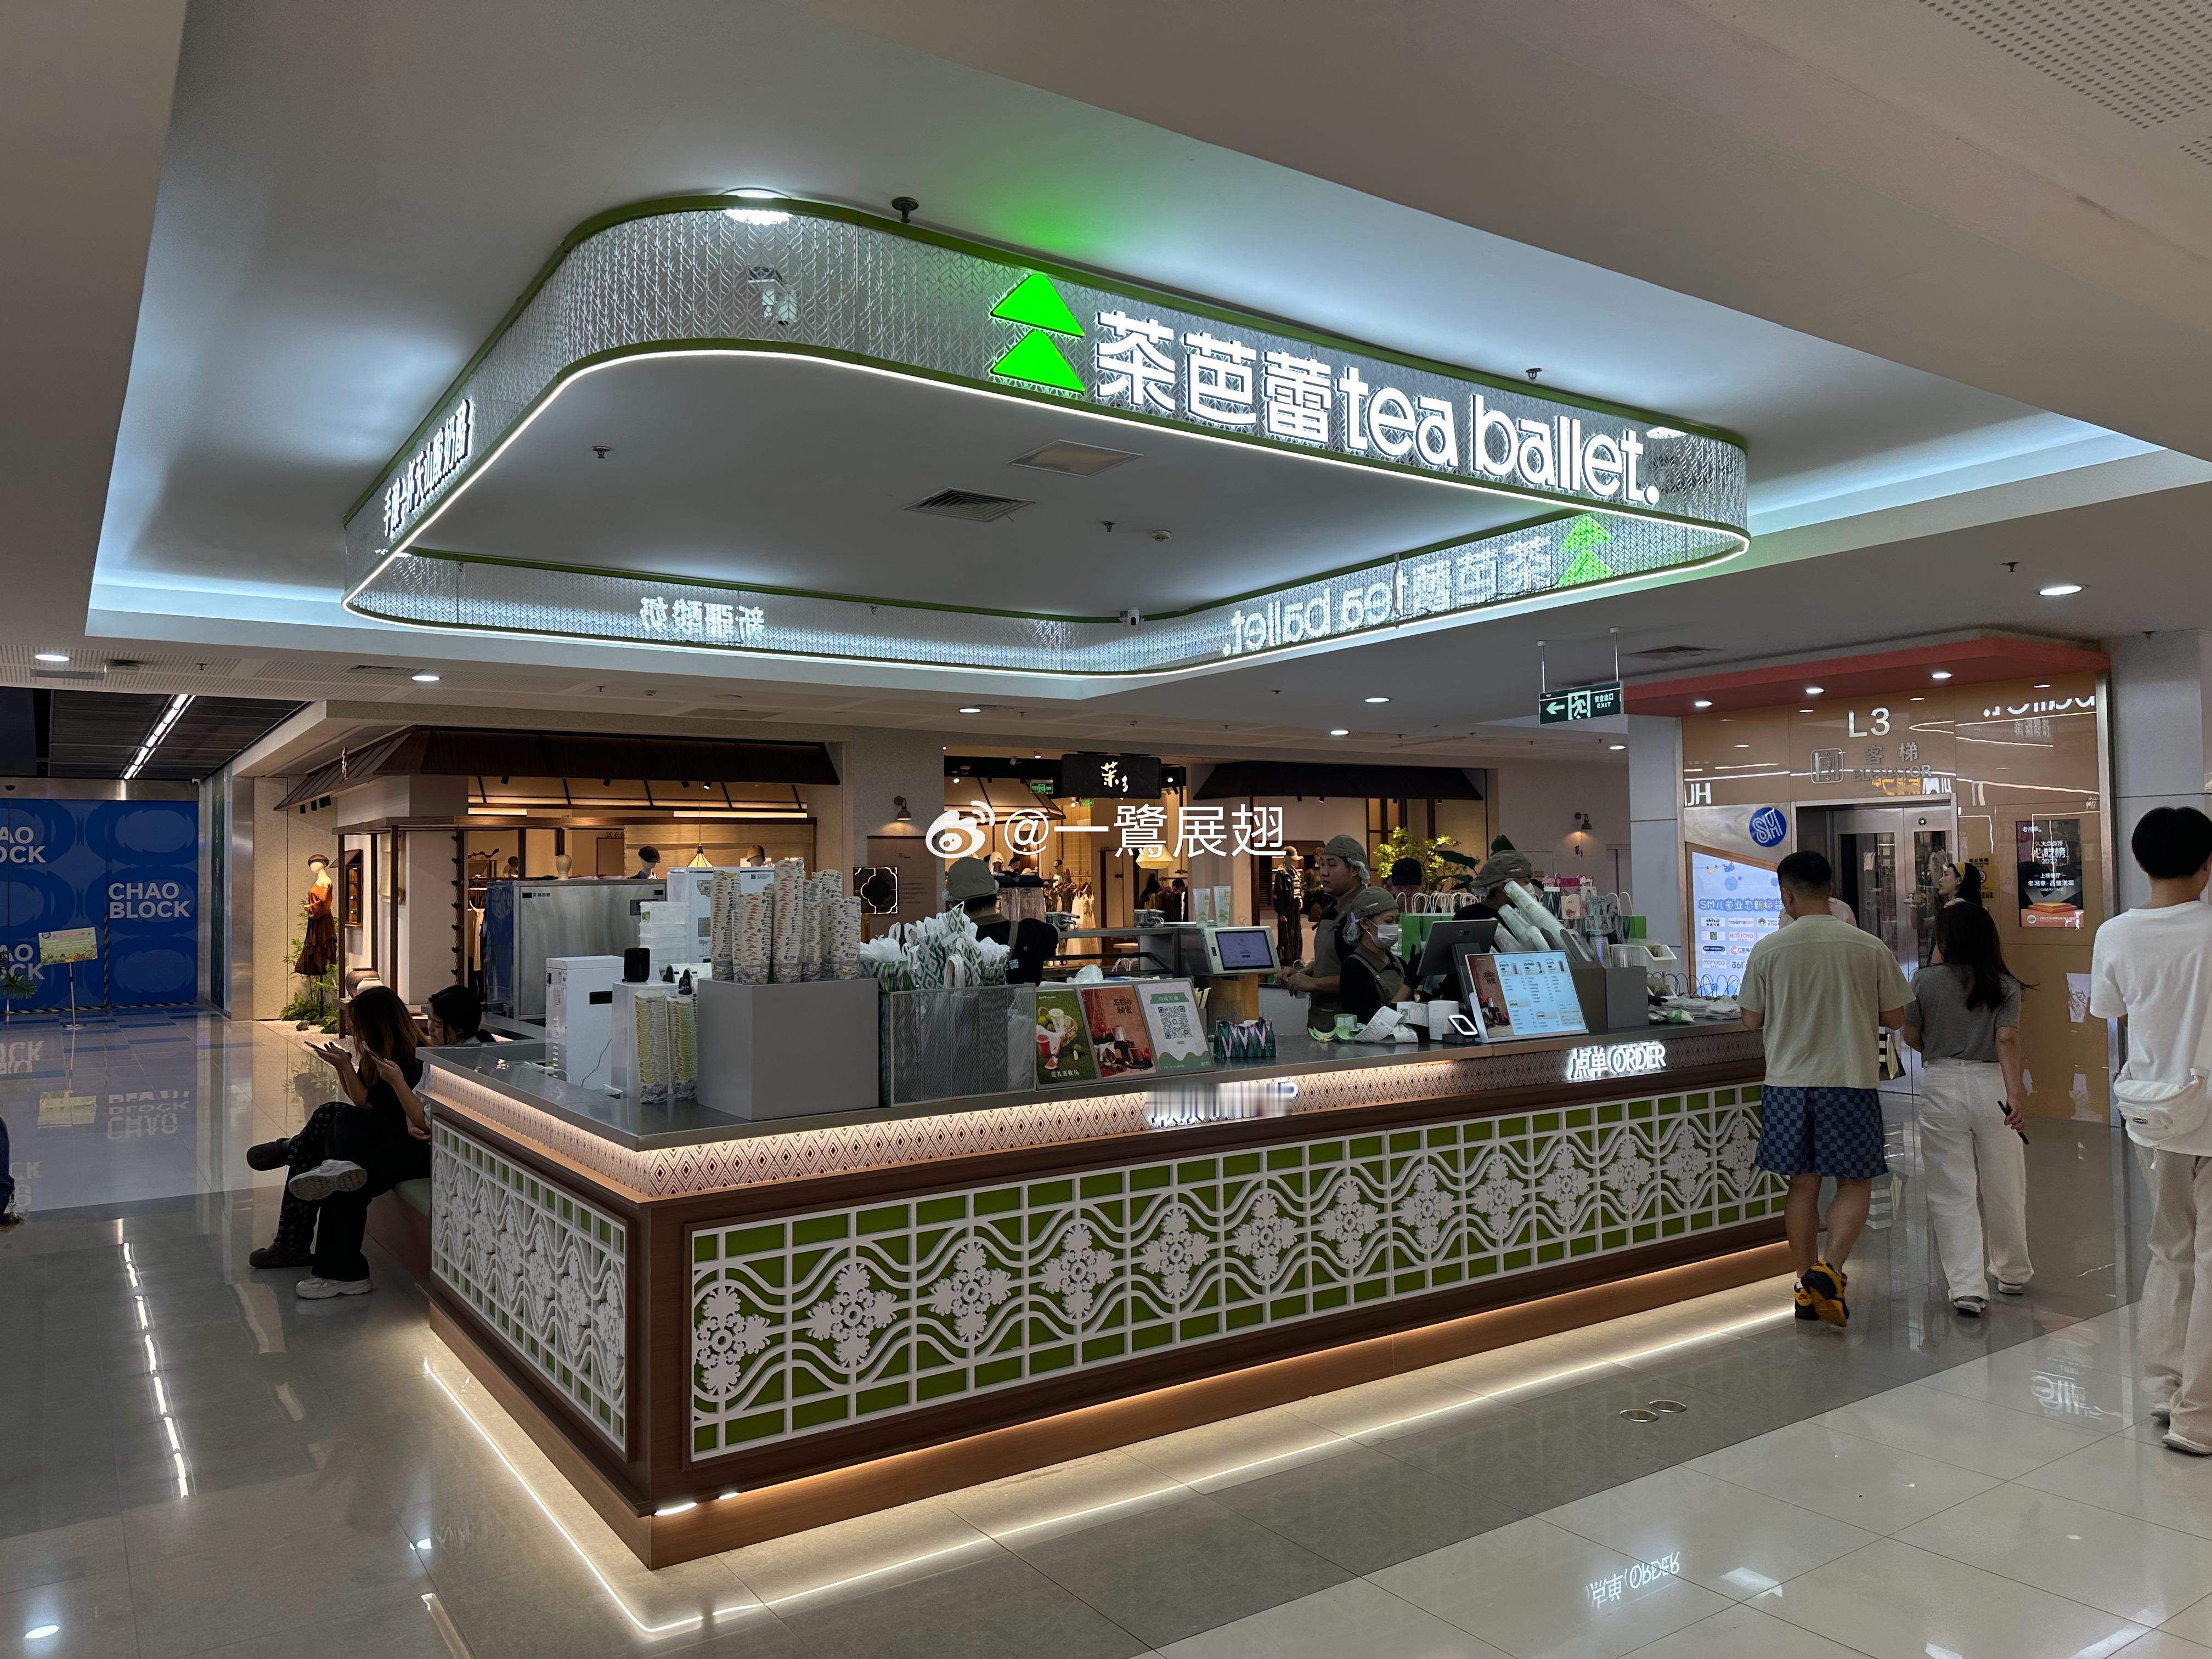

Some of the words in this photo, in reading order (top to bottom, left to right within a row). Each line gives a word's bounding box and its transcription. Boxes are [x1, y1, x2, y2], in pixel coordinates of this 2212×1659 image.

[1097, 310, 1331, 443] 茶芭蕾
[1337, 365, 1459, 468] tea
[1472, 393, 1660, 505] ballet.
[1848, 707, 1891, 738] L3
[1853, 764, 1932, 782] ELEVATOR
[108, 882, 179, 900] CHAO
[109, 900, 190, 919] BLOCK
[1573, 1046, 1608, 1080] 点单
[1612, 1045, 1667, 1073] ORDER
